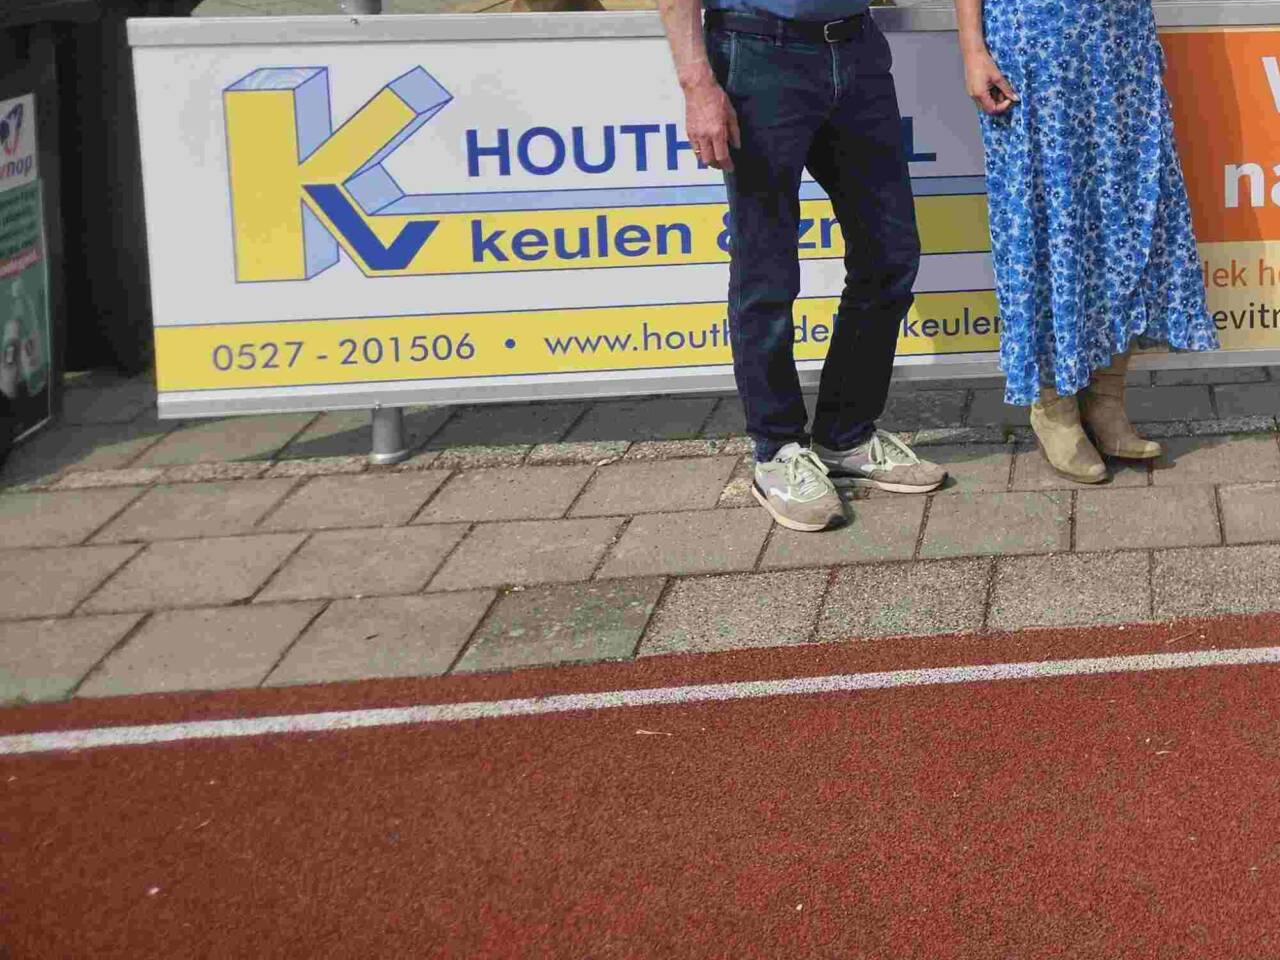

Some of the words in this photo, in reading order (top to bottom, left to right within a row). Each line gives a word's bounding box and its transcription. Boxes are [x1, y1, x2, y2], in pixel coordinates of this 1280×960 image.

[471, 216, 692, 264] keulen
[212, 341, 305, 371] 0527
[338, 333, 476, 366] 201506
